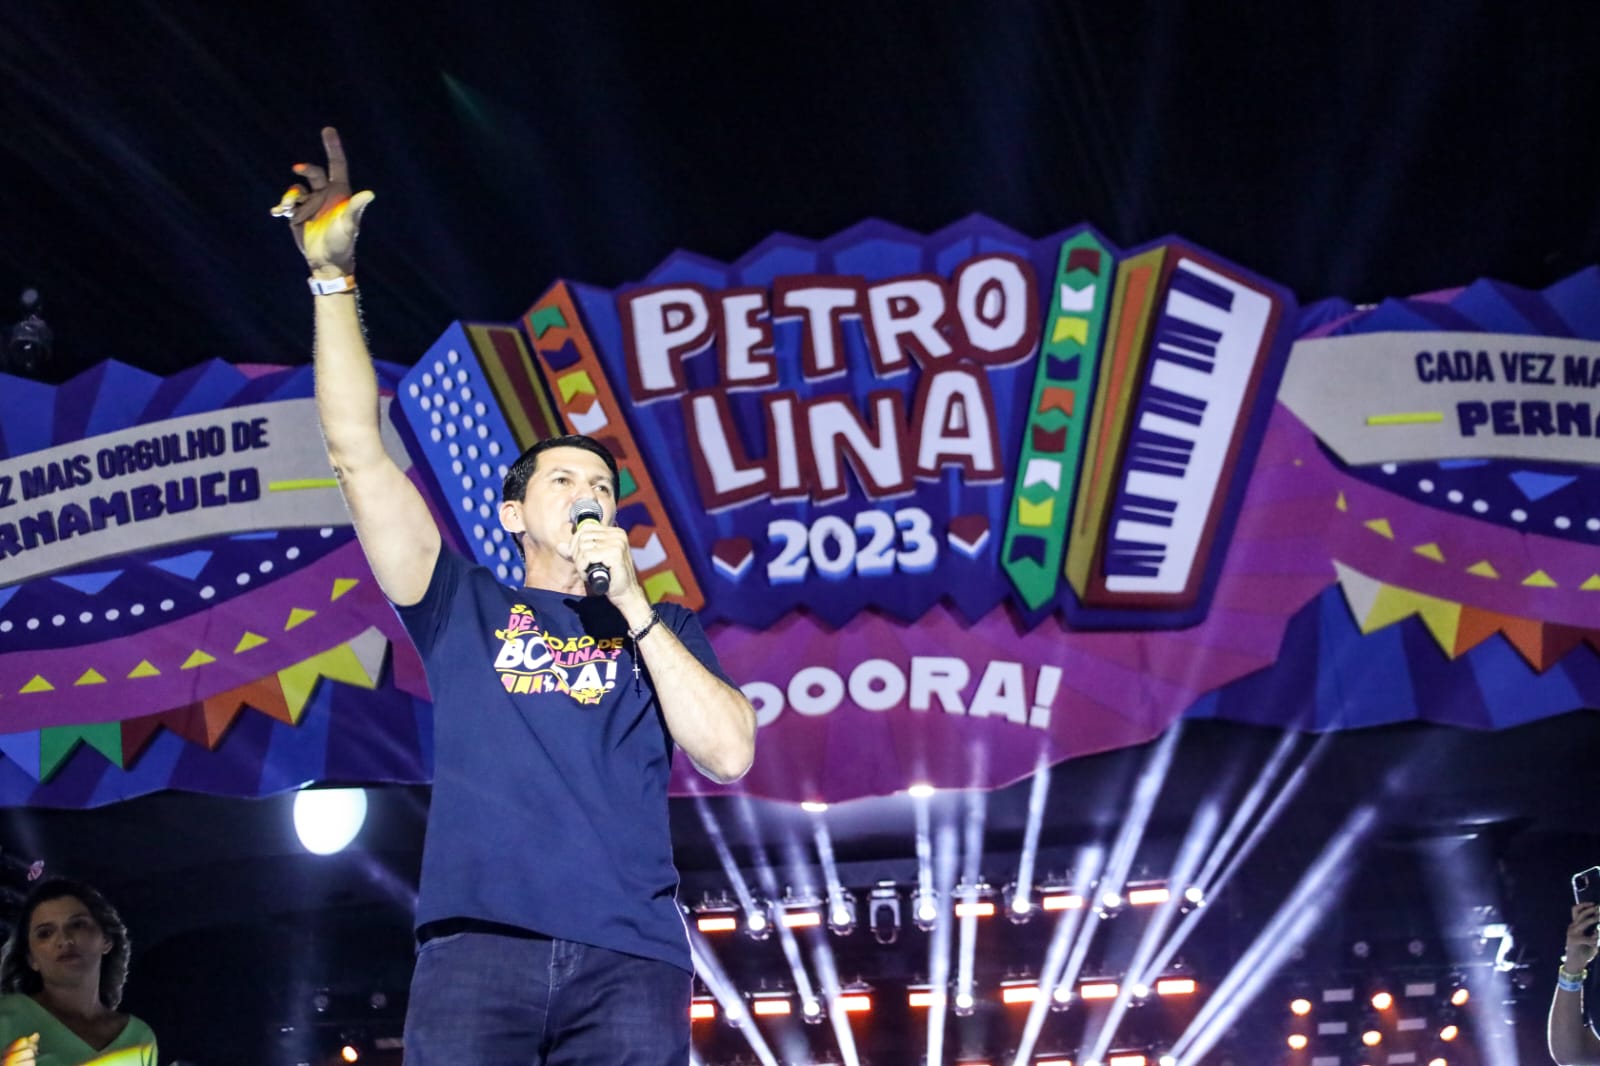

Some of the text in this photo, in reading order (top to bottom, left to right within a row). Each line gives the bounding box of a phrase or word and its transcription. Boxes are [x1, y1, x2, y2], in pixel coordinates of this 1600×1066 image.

[622, 254, 1036, 400] PETRO
[1415, 350, 1495, 384] CADA
[1500, 351, 1555, 386] VEZ
[19, 455, 92, 501] MAIS
[97, 426, 226, 480] ORGULHO
[232, 418, 269, 452] DE
[688, 369, 1000, 502] LINA
[1456, 400, 1600, 439] PERN
[766, 507, 938, 585] 2023
